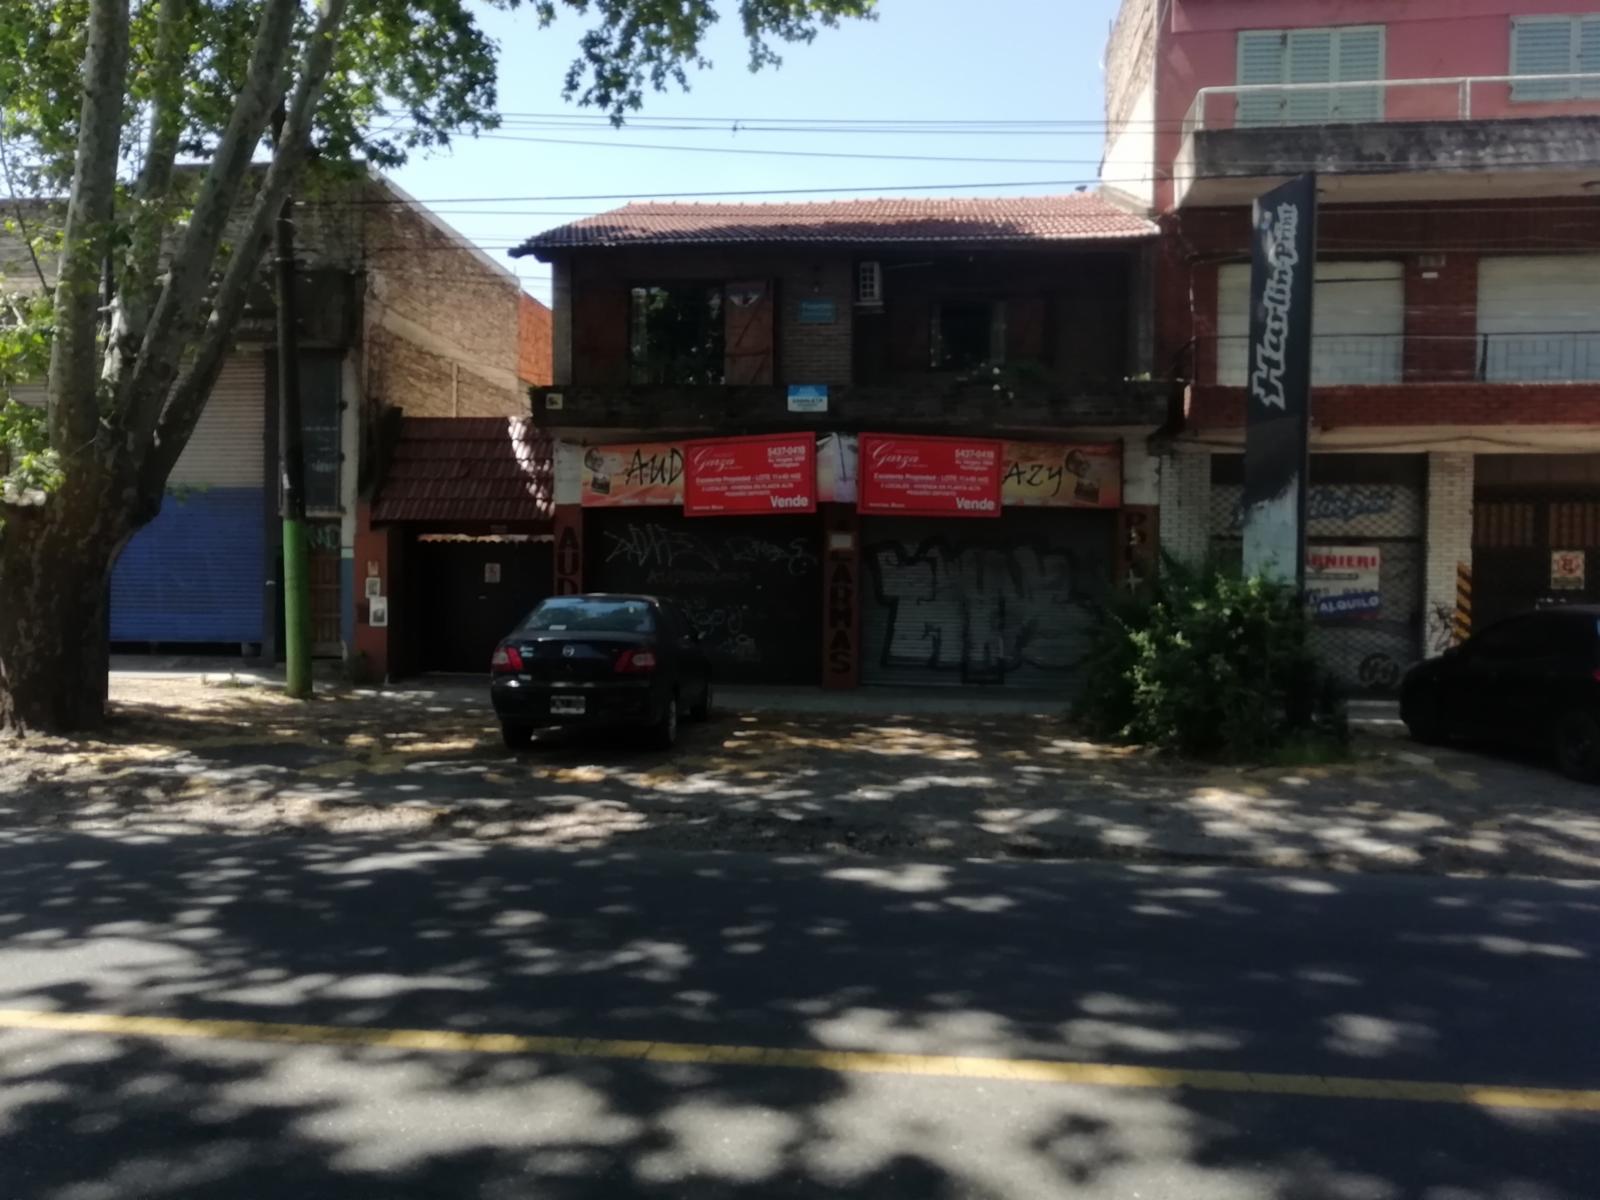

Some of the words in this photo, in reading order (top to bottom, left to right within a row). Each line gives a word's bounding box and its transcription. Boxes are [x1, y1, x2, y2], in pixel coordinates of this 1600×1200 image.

[770, 495, 809, 508] Vende
[955, 497, 995, 511] Vende
[1319, 595, 1380, 613] ALQUILO
